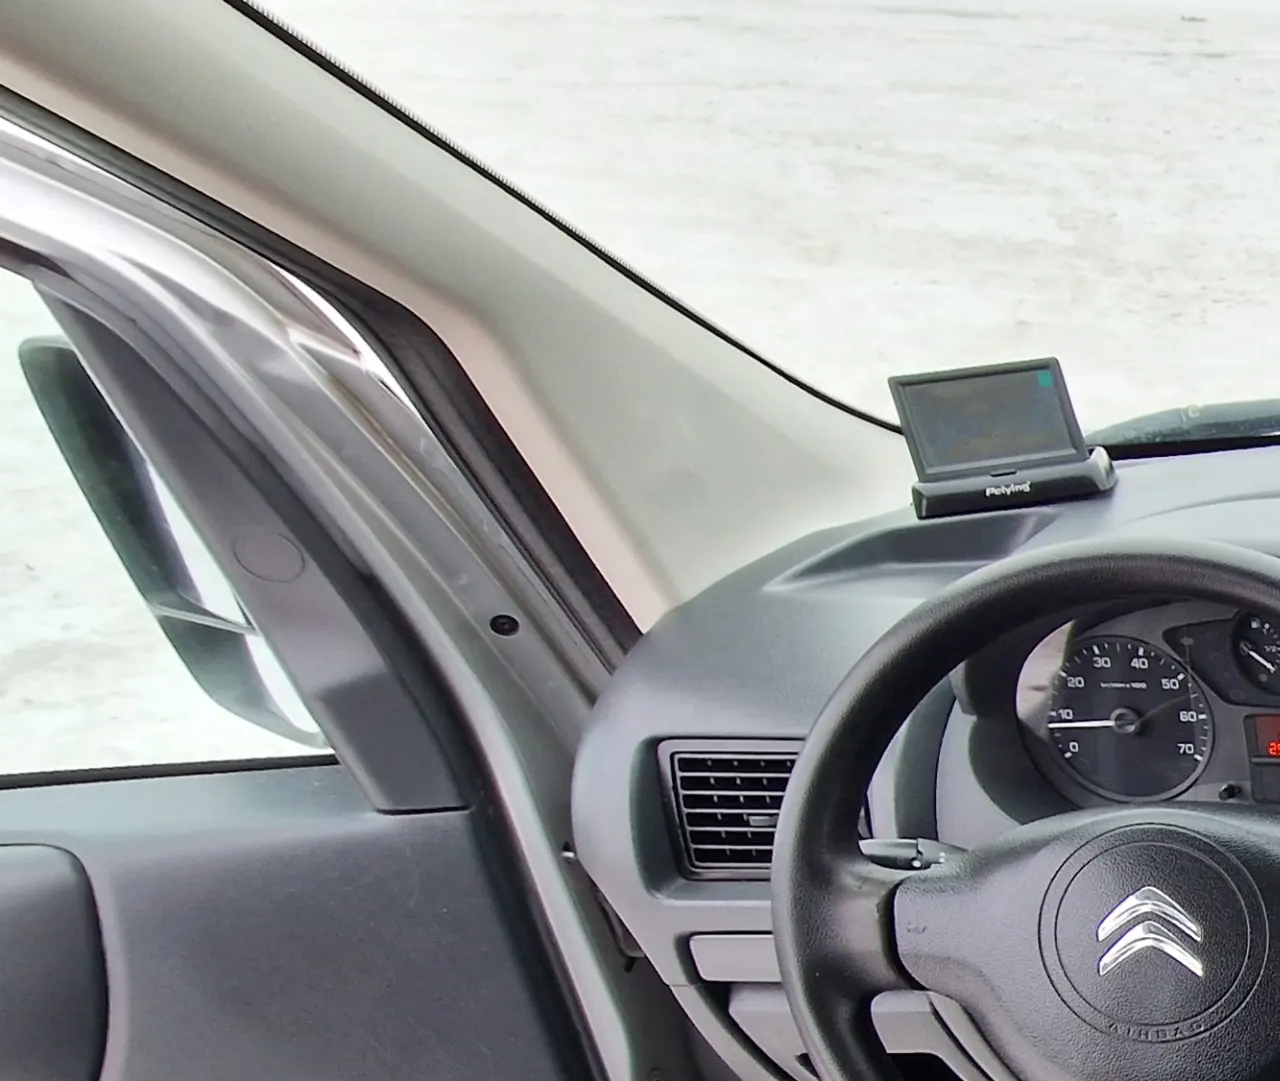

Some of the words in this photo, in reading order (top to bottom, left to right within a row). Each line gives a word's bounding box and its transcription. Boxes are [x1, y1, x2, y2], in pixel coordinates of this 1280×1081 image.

[1092, 657, 1111, 668] 30
[1130, 658, 1149, 669] 40
[1067, 676, 1085, 688] 20
[1161, 679, 1180, 690] 50
[1058, 709, 1074, 720] 10
[1179, 711, 1197, 722] 60
[1069, 741, 1079, 752] 0
[1177, 743, 1194, 754] 70
[1108, 1021, 1204, 1040] AIRBAG
